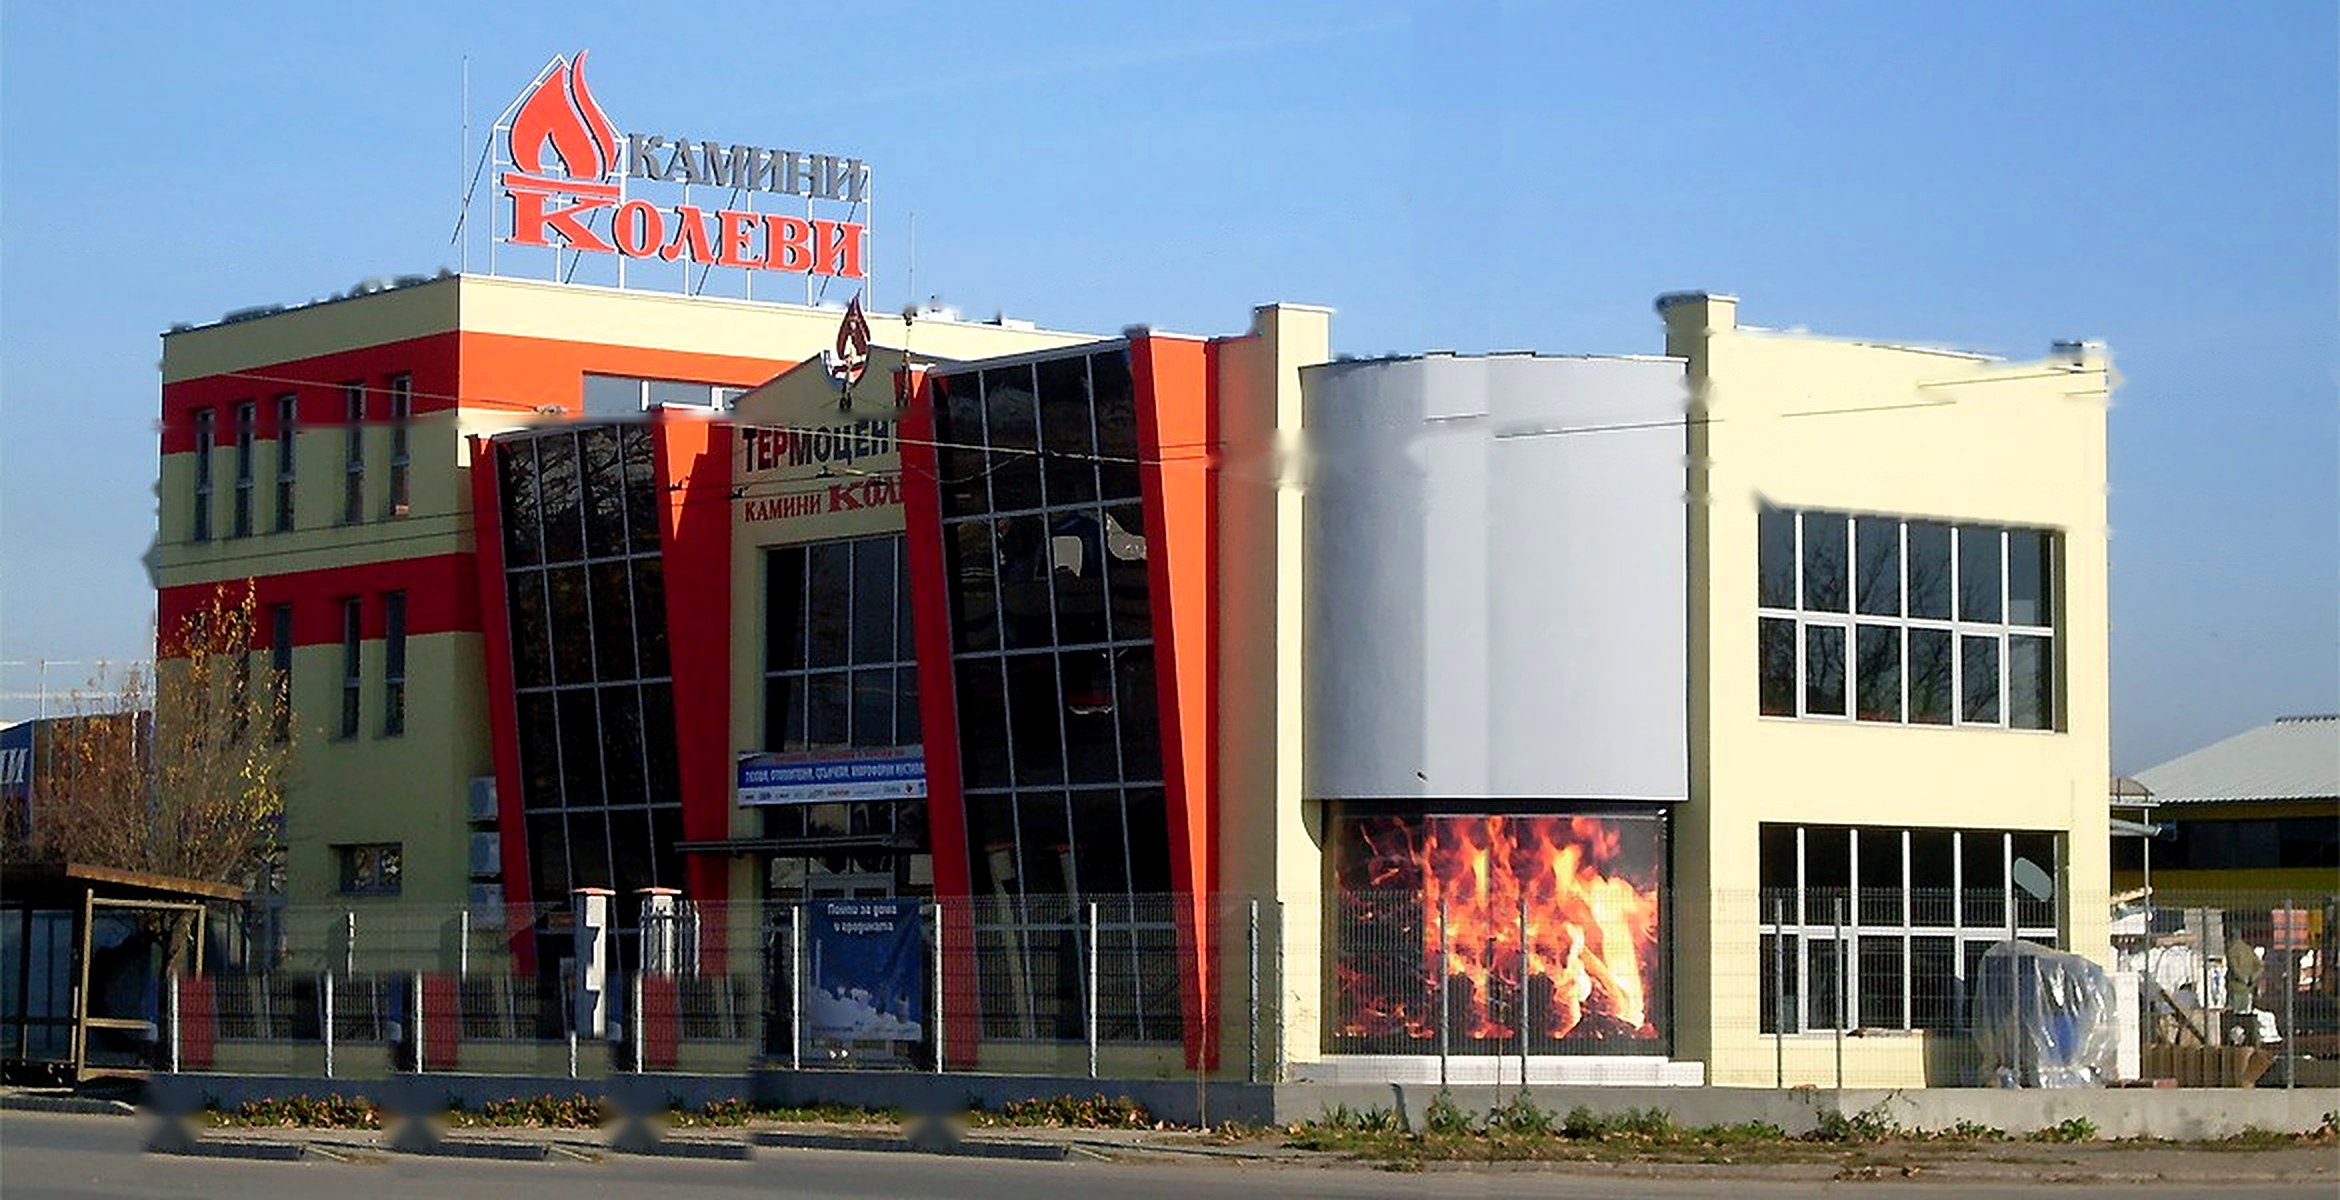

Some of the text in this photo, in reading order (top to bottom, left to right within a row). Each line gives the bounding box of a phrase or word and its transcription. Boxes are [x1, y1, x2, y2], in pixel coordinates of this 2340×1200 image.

[627, 132, 863, 202] КАМИНИ
[505, 189, 866, 278] КОЛЕВИ
[745, 476, 903, 522] КАМИНИ КОЛ
